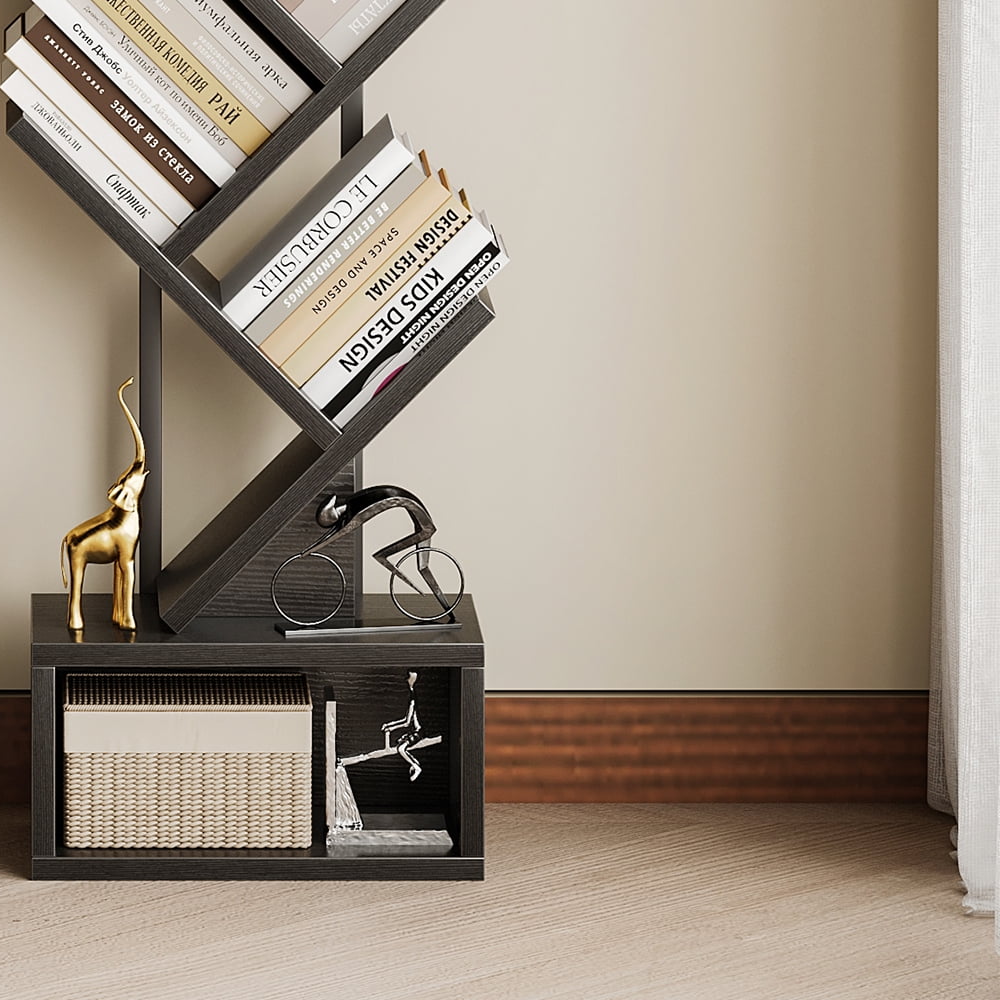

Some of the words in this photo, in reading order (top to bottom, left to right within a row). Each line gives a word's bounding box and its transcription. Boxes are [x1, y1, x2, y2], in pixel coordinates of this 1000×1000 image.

[72, 23, 94, 46] Стив
[91, 44, 123, 75] Джобс
[117, 34, 158, 77] Уличный
[154, 74, 172, 91] кот
[207, 124, 229, 146] Боб
[161, 46, 209, 94] КОМЕДИЯ
[207, 92, 243, 126] РАЙ
[261, 64, 288, 90] арка
[110, 99, 145, 134] замок
[143, 132, 159, 148] из
[158, 147, 194, 185] стекла
[105, 173, 151, 219] Спартак
[348, 174, 378, 203] LE
[375, 201, 390, 218] BE
[252, 199, 353, 298] CORBUSIER
[340, 214, 376, 250] BETTER
[367, 227, 399, 259] SPACE
[413, 208, 460, 254] DESIGN
[283, 248, 342, 309] RENDERINGS
[347, 256, 368, 279] AND
[364, 250, 418, 302] FESTIVAL
[462, 250, 494, 281] OPEN
[474, 261, 501, 289] OPEN
[311, 278, 348, 315] DESIGN
[400, 267, 445, 312] KIDS
[427, 275, 468, 317] DESIGN
[439, 287, 475, 324] DESIGN
[338, 306, 406, 373] DESIGN
[400, 311, 432, 345] NIGHT
[410, 321, 441, 353] NIGHT
